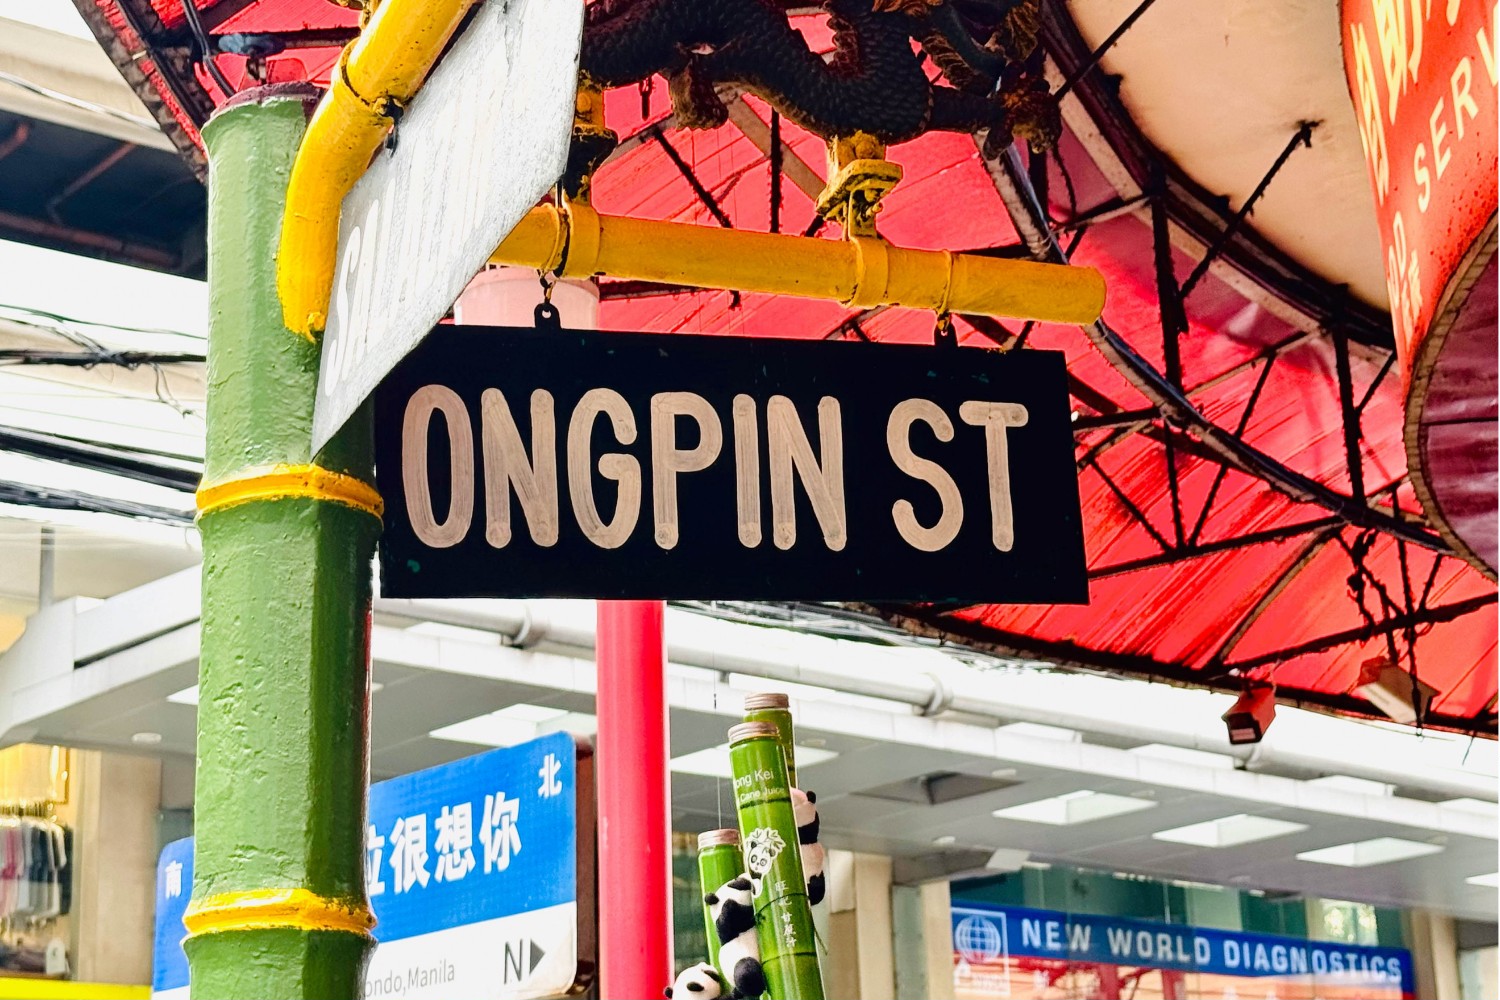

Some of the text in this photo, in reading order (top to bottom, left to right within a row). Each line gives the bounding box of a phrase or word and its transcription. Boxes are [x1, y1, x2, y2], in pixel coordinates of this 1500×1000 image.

[402, 384, 1029, 552] ONGPIN ST
[538, 753, 562, 798] 北
[754, 769, 774, 782] Kei
[165, 860, 183, 899] 南
[504, 939, 523, 985] N
[1021, 918, 1403, 984] NEW WORLD DIAGNOSTICS
